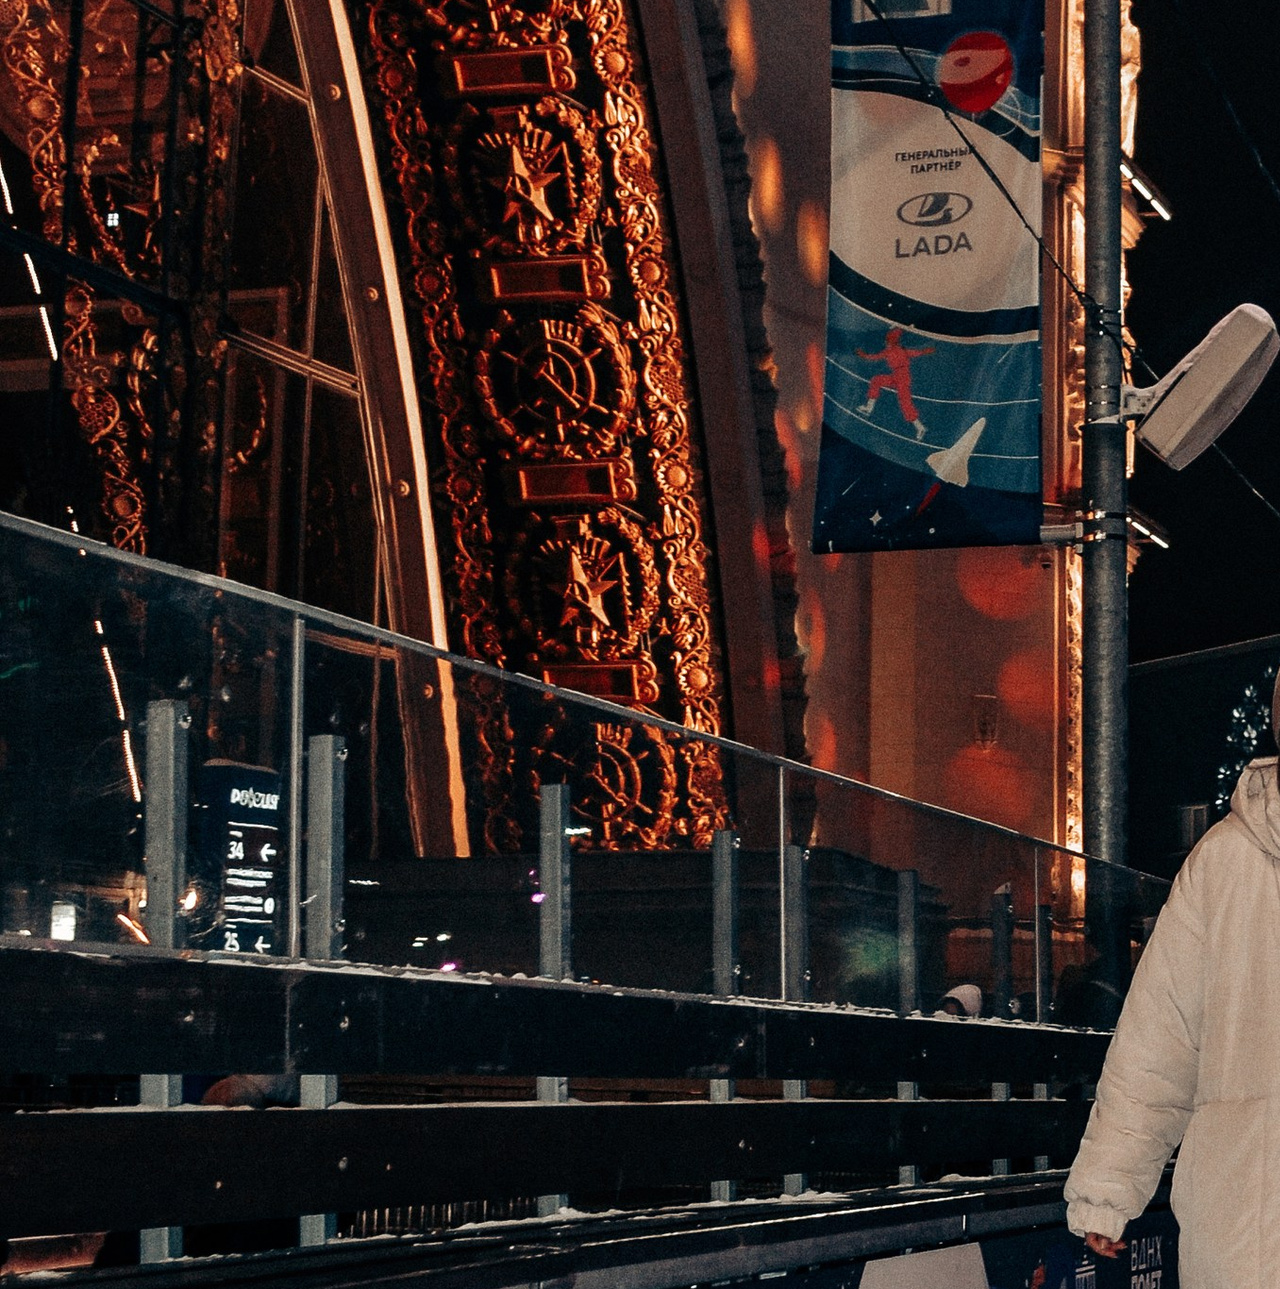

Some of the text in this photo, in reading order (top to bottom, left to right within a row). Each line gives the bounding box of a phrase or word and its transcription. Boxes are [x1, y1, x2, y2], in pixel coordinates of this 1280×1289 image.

[895, 146, 976, 162] ГЕНЕРАЛЬНЫ
[895, 232, 973, 259] LADA
[227, 841, 245, 860] 34
[1129, 1235, 1163, 1272] ВДНХ
